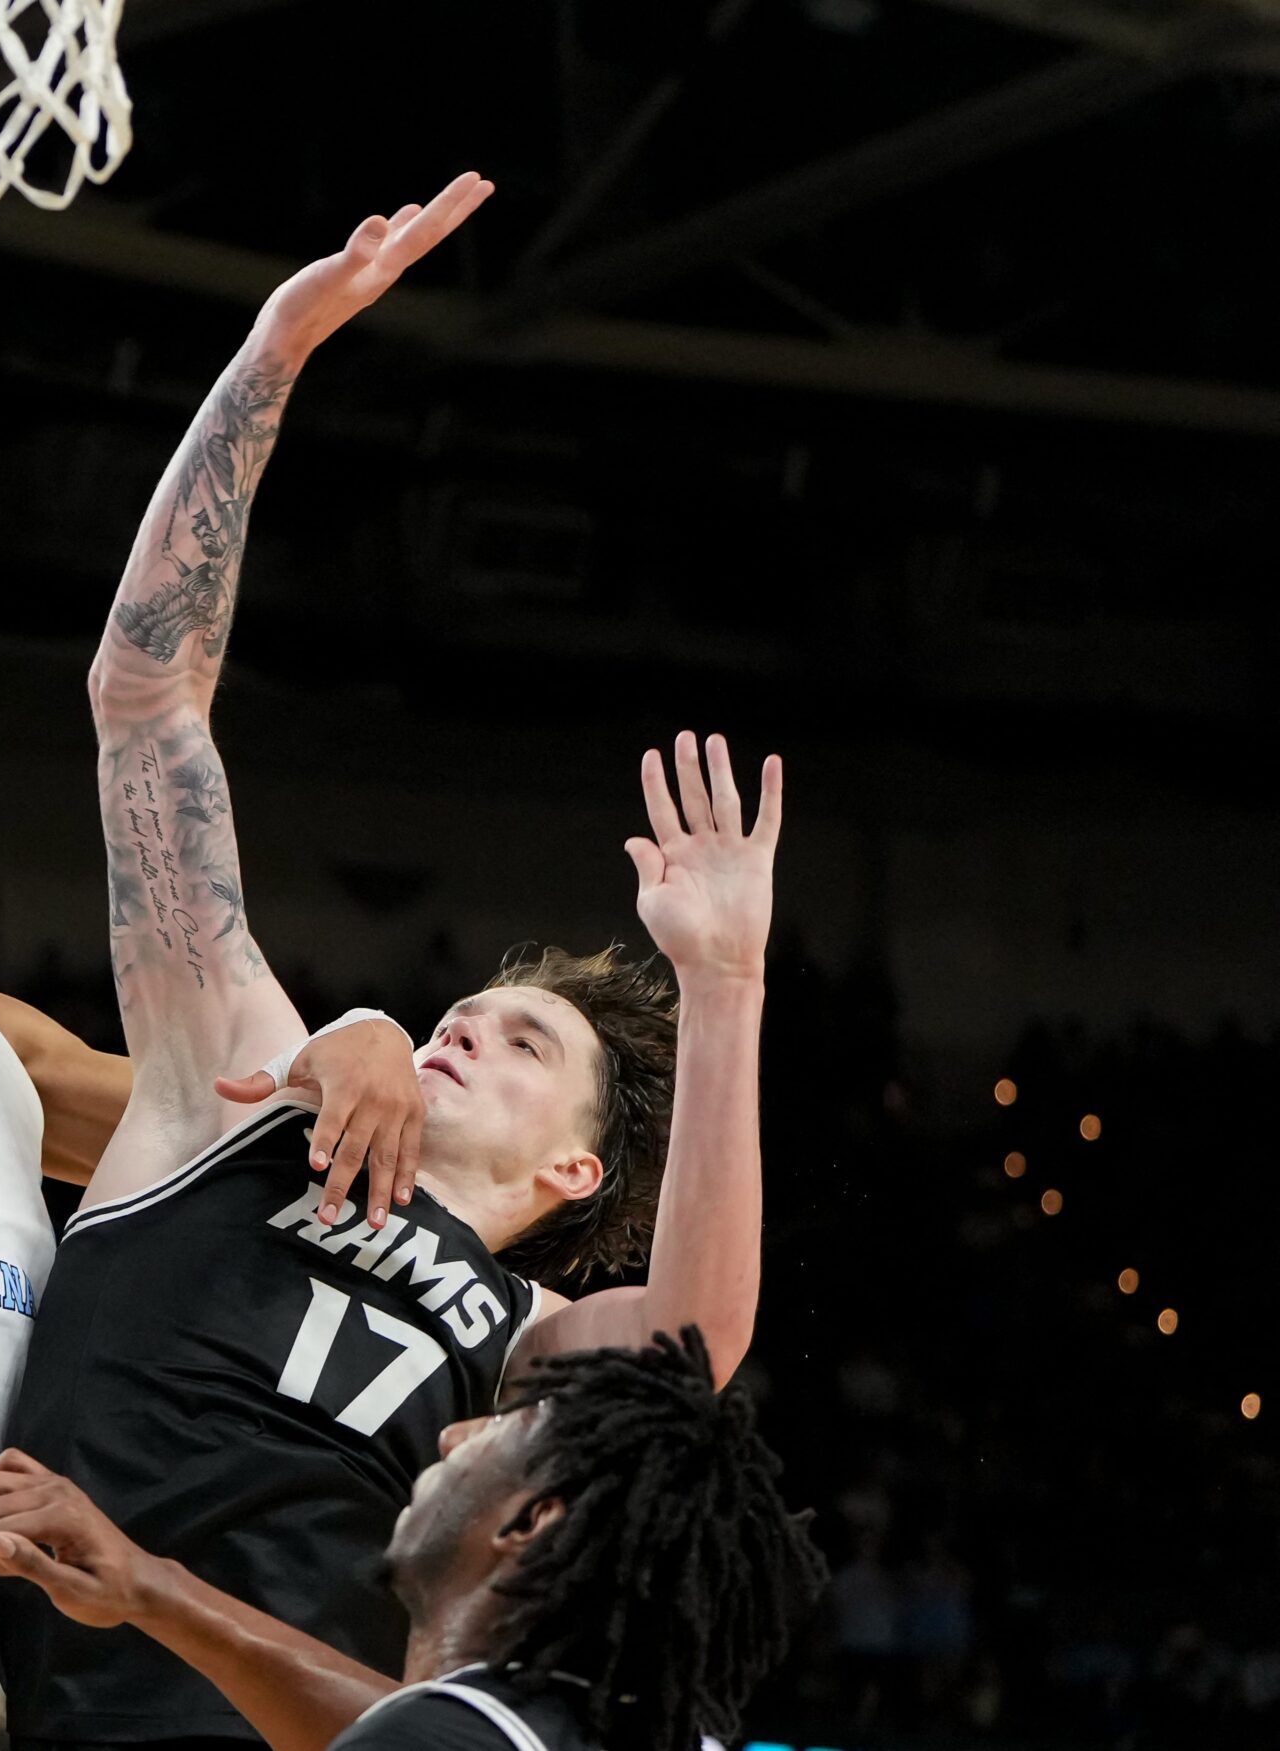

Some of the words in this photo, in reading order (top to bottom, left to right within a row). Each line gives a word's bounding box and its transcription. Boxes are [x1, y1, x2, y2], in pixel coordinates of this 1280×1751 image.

[138, 743, 160, 780] The
[144, 807, 163, 843] power
[123, 780, 138, 801] the
[149, 886, 168, 924] within
[161, 846, 180, 878] that
[187, 960, 204, 989] from
[266, 1181, 507, 1349] RAMS
[276, 1276, 448, 1437] 17
